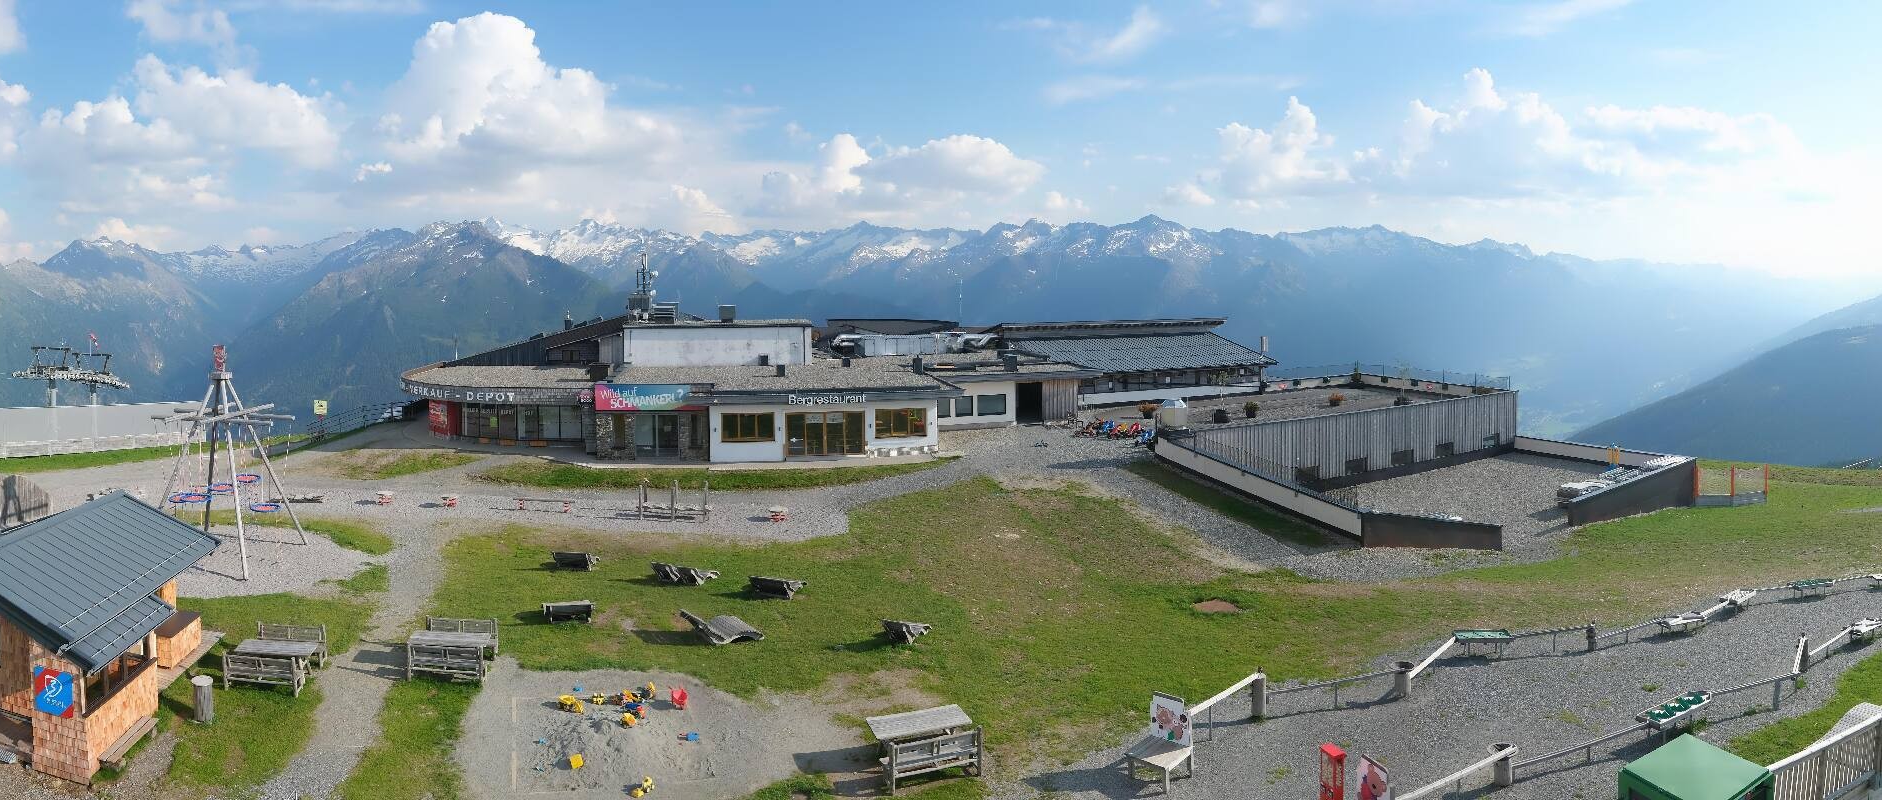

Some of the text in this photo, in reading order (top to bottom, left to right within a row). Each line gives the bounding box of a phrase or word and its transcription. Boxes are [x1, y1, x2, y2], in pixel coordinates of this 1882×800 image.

[409, 384, 450, 399] VERKAUF
[466, 391, 514, 401] DEPOT
[601, 389, 620, 399] Wild
[623, 387, 637, 397] auf
[788, 394, 866, 406] Bergrestaurant
